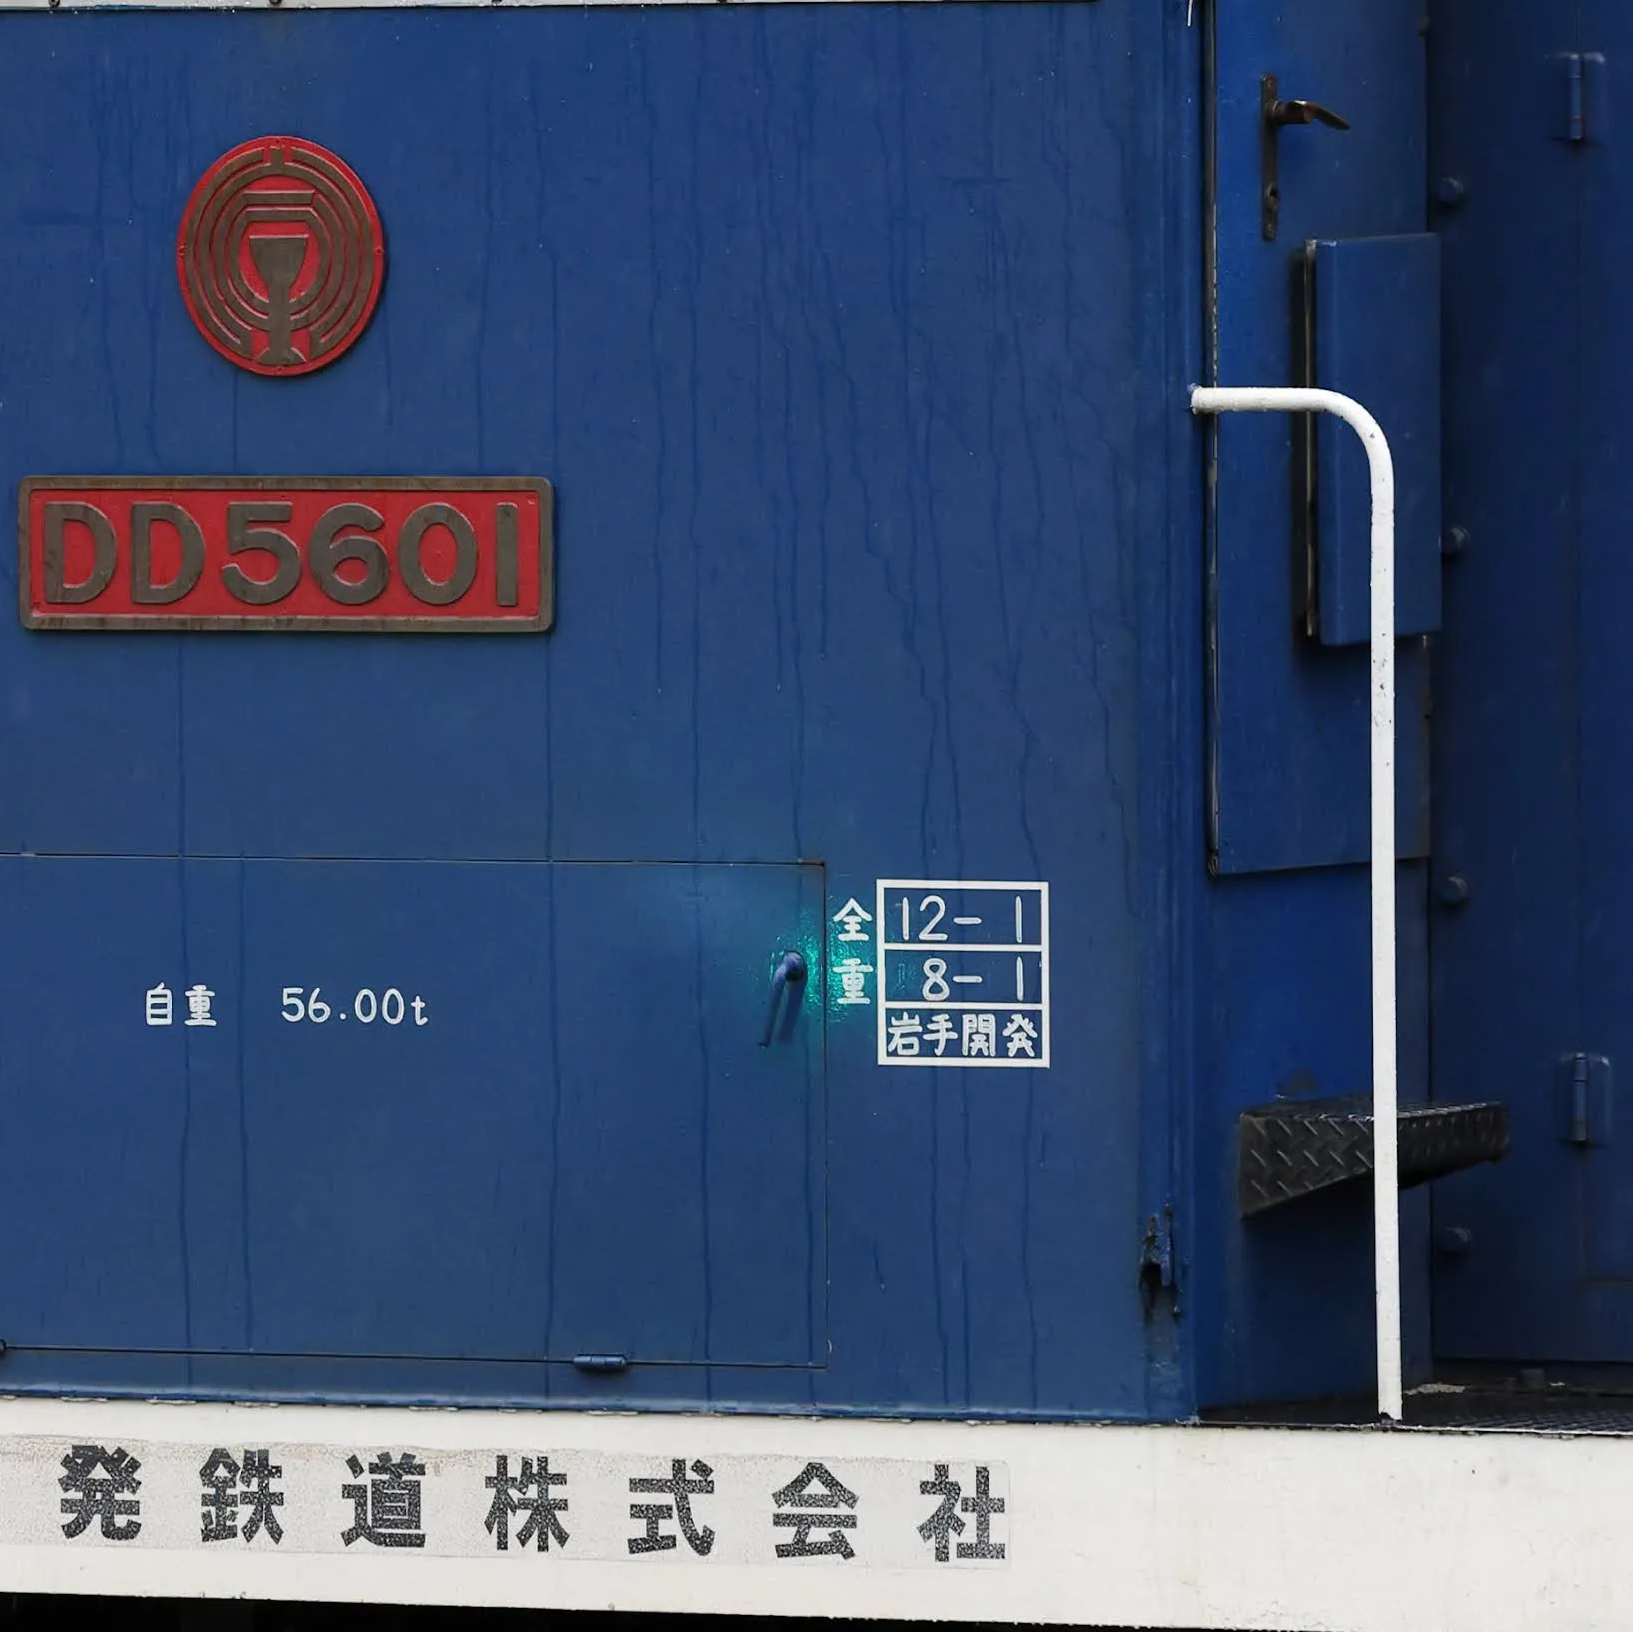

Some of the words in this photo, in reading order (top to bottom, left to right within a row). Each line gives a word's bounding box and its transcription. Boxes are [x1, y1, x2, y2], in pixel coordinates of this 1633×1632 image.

[42, 500, 518, 607] DD5601
[887, 1011, 1039, 1058] 岩手開発
